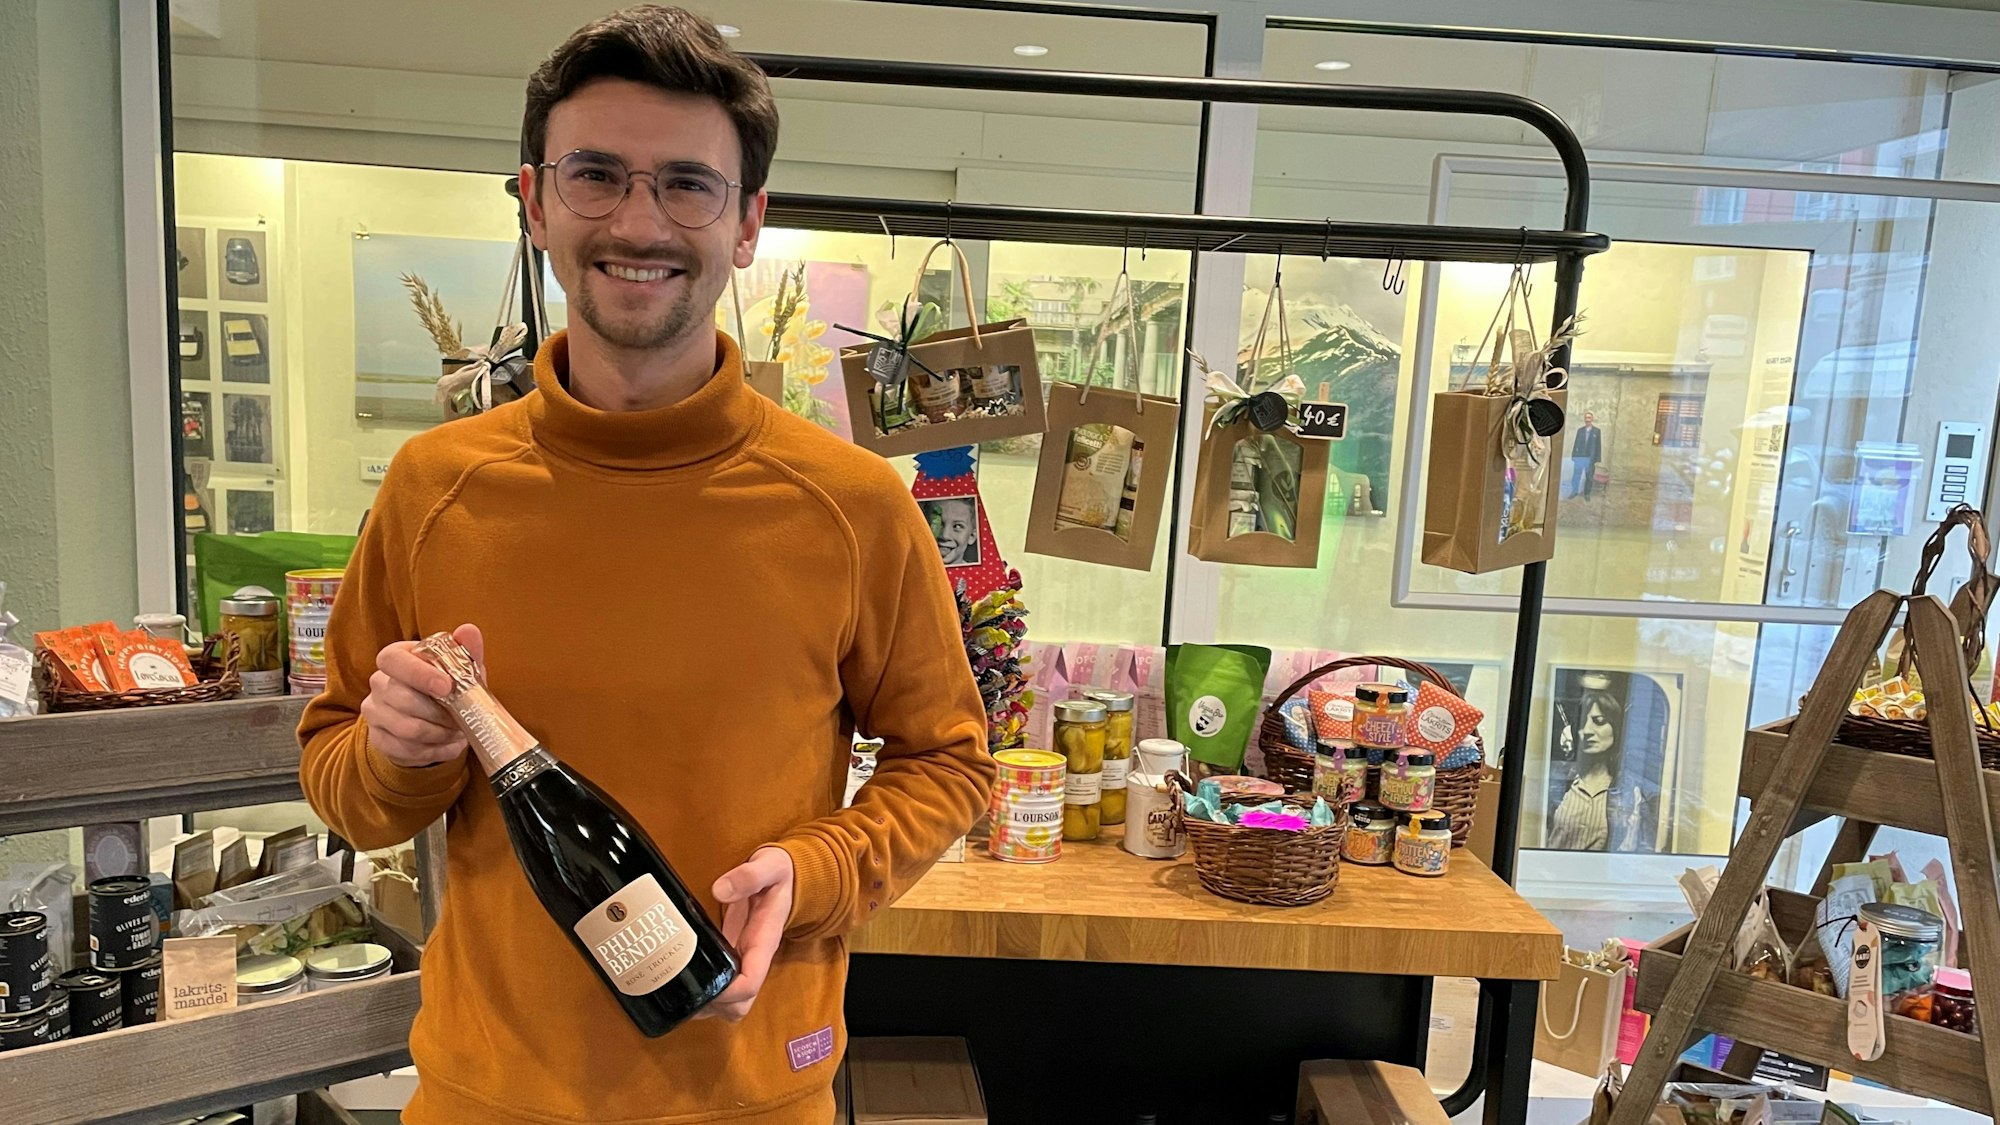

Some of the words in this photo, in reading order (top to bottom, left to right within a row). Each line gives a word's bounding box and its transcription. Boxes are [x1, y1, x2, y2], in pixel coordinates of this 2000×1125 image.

[118, 645, 134, 670] HAPPY
[137, 643, 192, 675] BIRTHDAY
[460, 708, 501, 759] PHILIPP
[1365, 720, 1396, 733] CHEEZY
[1421, 714, 1452, 734] LAKRITS
[1368, 732, 1392, 743] STYLE
[1014, 811, 1059, 822] L'OURSON
[116, 917, 141, 932] OLIVES
[597, 902, 667, 961] PHILIPP
[607, 918, 681, 975] BENDER
[647, 940, 684, 971] TROCKEN
[173, 983, 227, 998] lakrits-
[174, 992, 229, 1010] mandel
